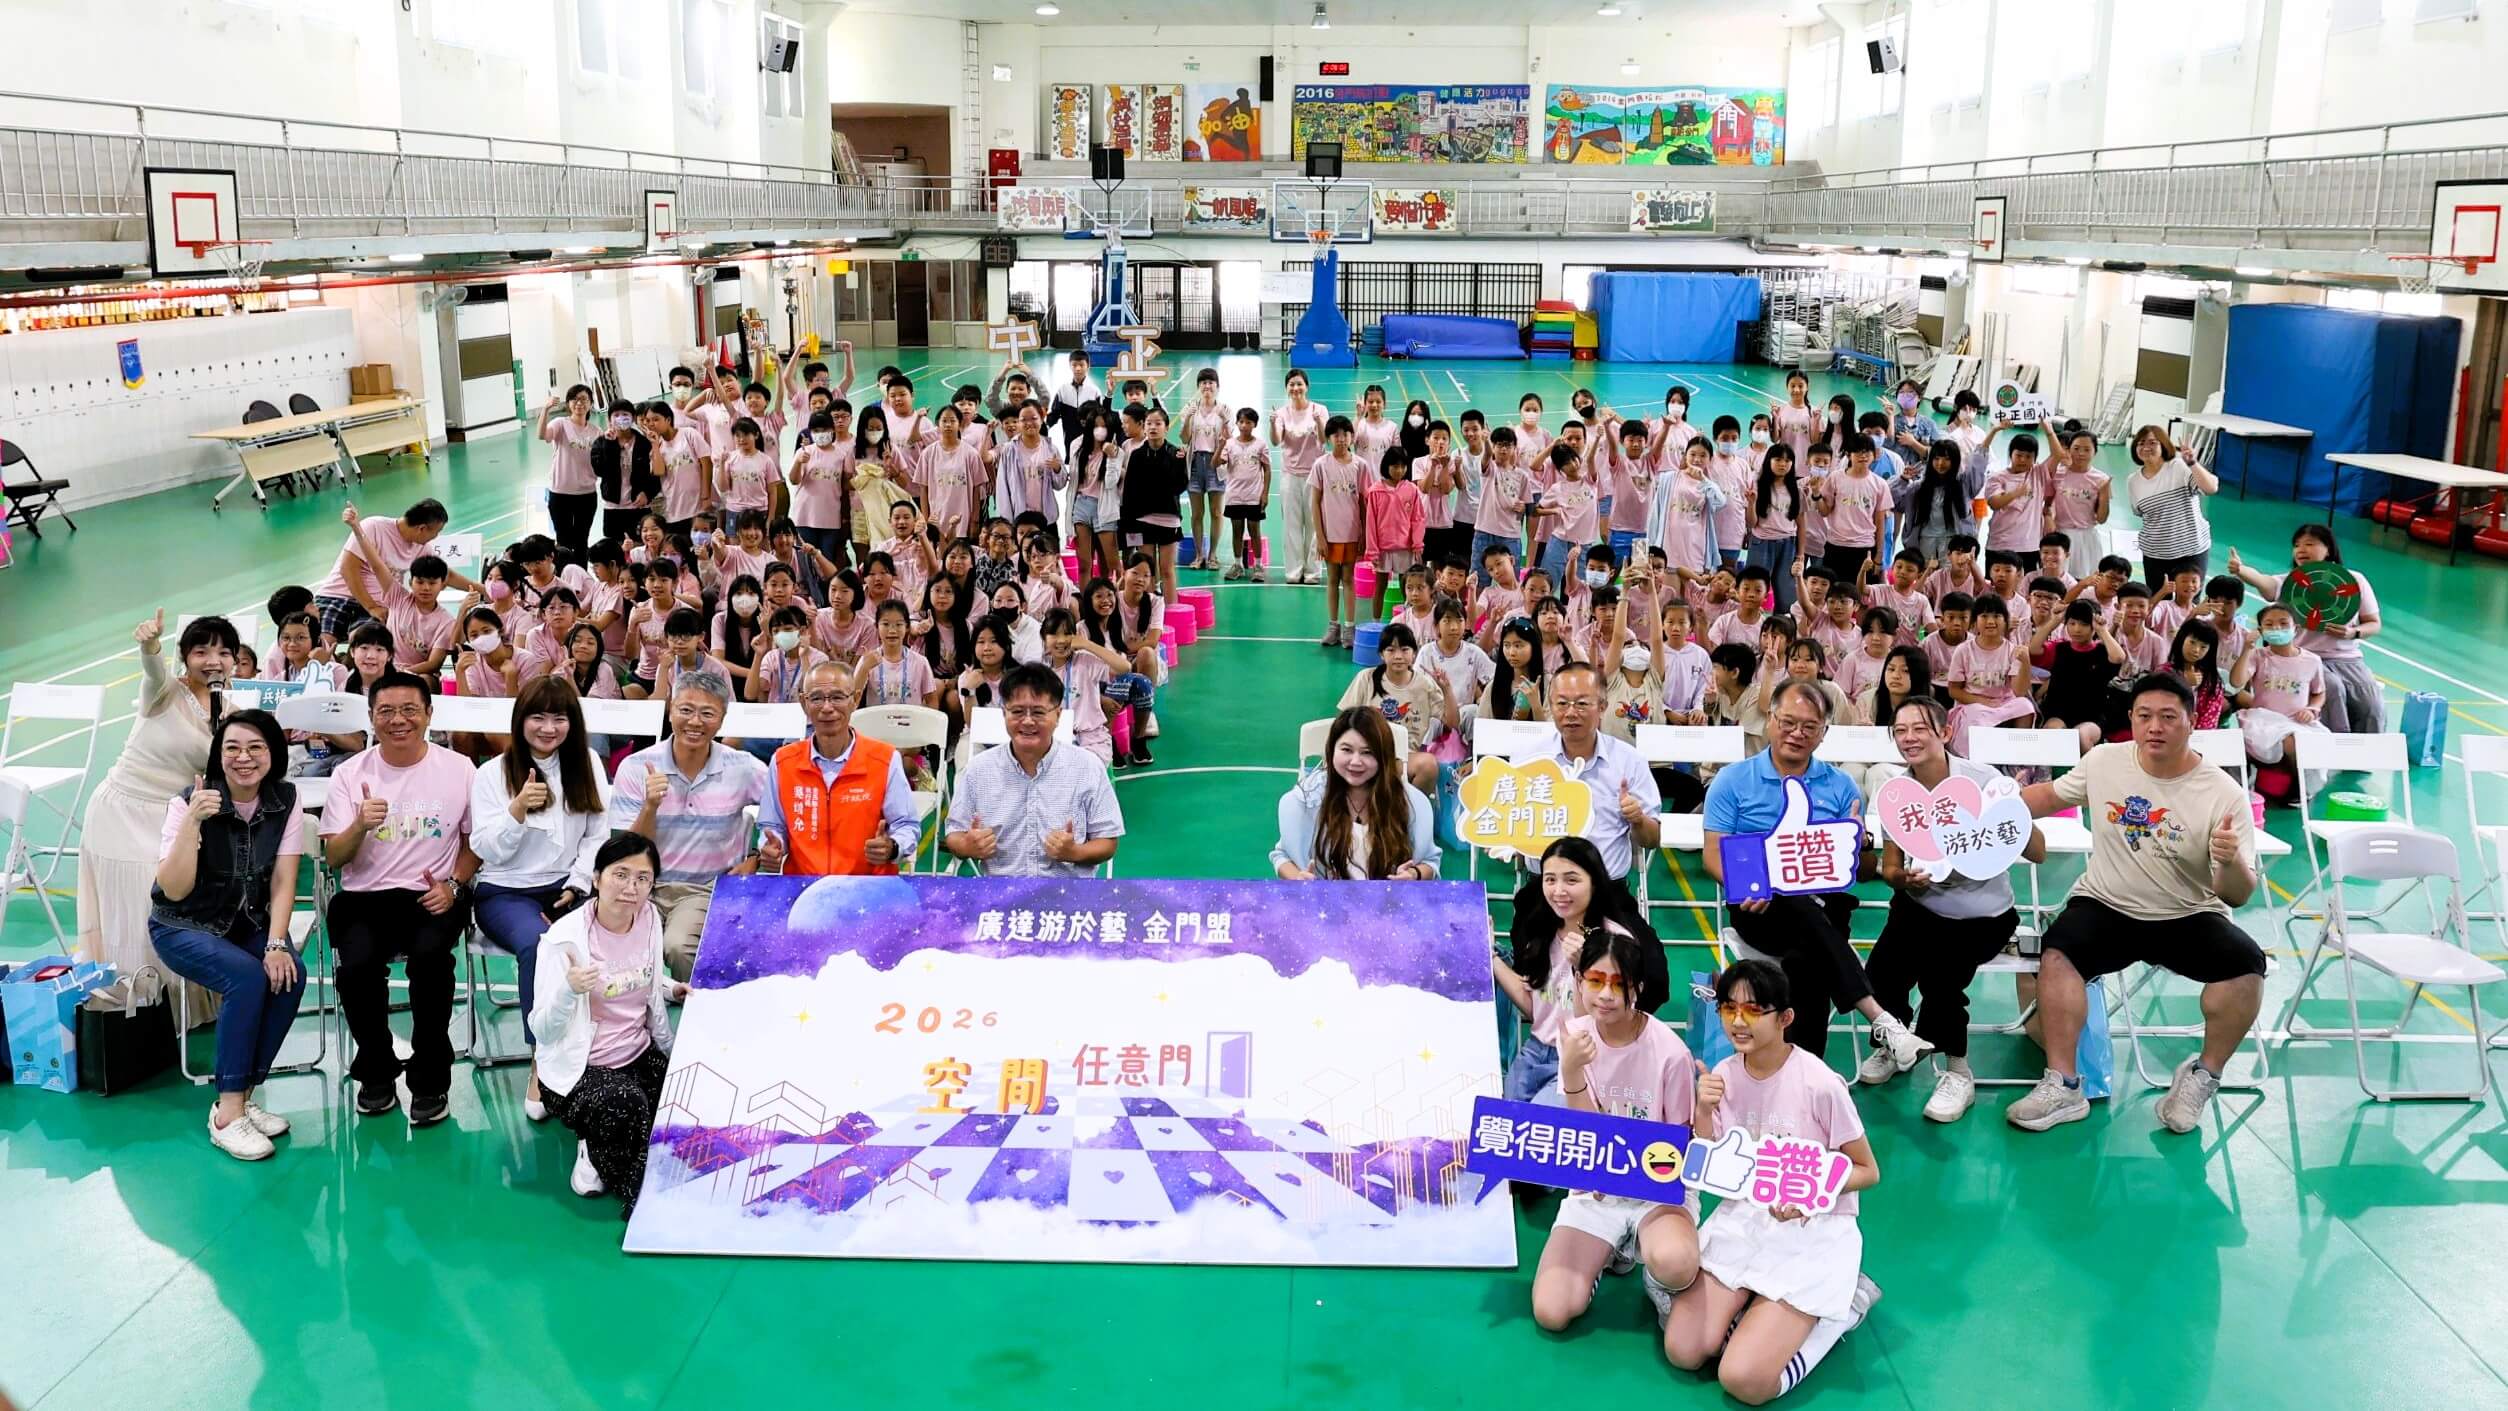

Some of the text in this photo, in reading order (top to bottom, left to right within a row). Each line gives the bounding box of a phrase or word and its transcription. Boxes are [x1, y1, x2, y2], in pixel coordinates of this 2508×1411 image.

[1296, 88, 1334, 98] 2016
[1199, 196, 1257, 218] 一帆風順
[989, 318, 1037, 365] 中
[1112, 329, 1167, 376] 正
[1995, 408, 2050, 421] 中正國小
[1490, 774, 1553, 804] 廣達
[1472, 805, 1569, 838] 金門盟
[1899, 799, 1961, 832] 我愛
[1944, 822, 2021, 857] 游於藝
[1777, 831, 1838, 884] 讚
[975, 911, 1233, 943] 廣達游於藝 金門盟
[875, 1003, 997, 1034] 2026
[1072, 1044, 1191, 1087] 任意門
[1473, 1115, 1636, 1174] 覺得開心
[1753, 1140, 1849, 1210] 讚!
